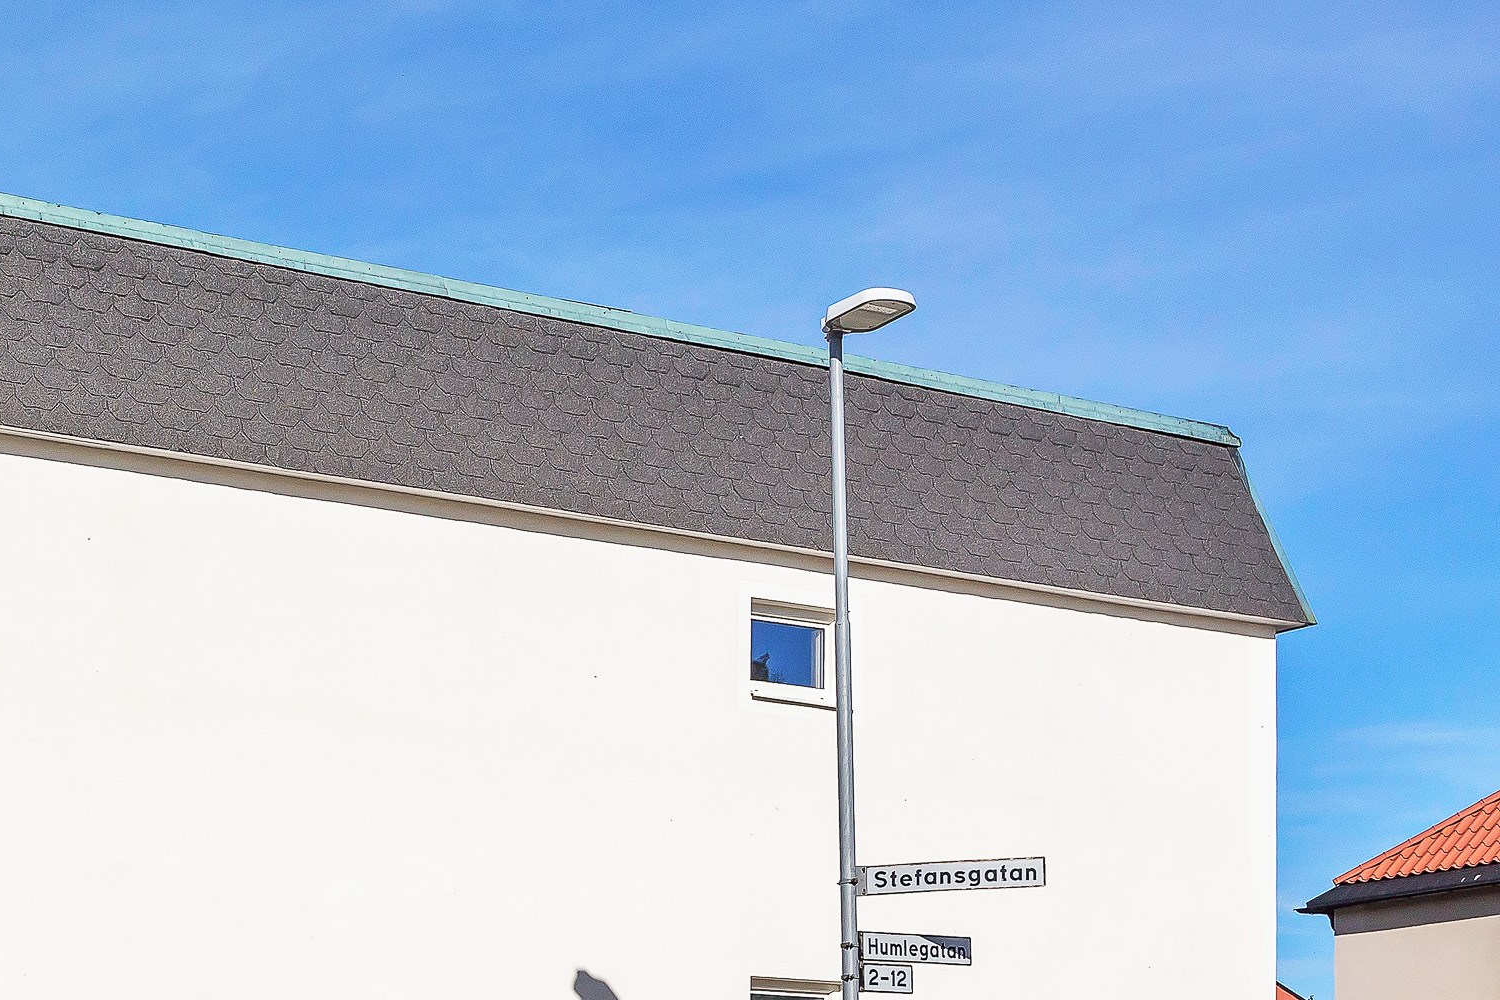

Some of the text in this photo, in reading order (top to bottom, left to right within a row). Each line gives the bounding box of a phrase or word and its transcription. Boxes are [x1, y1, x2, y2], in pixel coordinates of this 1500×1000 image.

[874, 864, 1038, 888] Stefansgatan
[867, 937, 967, 962] Humlegatan
[867, 968, 908, 988] 2-12
